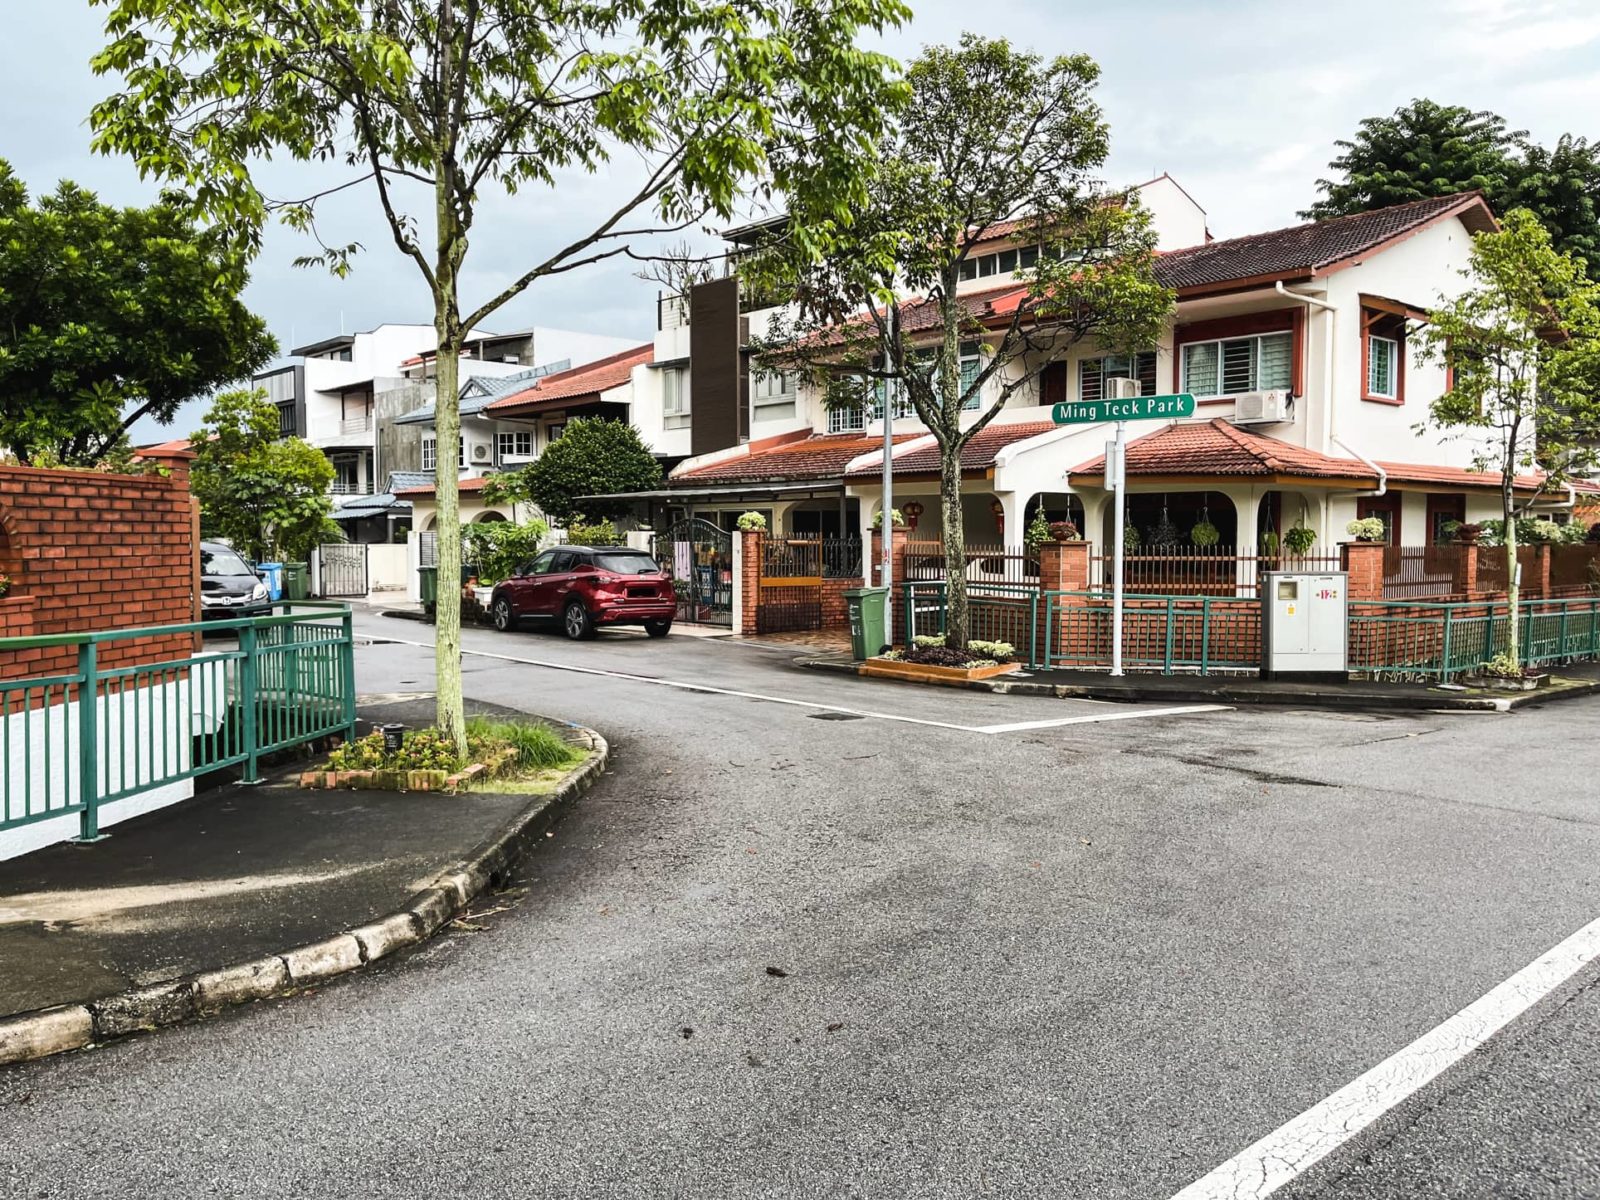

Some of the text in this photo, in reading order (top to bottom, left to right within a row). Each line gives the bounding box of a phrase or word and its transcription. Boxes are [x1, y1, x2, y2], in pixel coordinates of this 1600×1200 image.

[1060, 397, 1184, 420] Ming Teck Park
